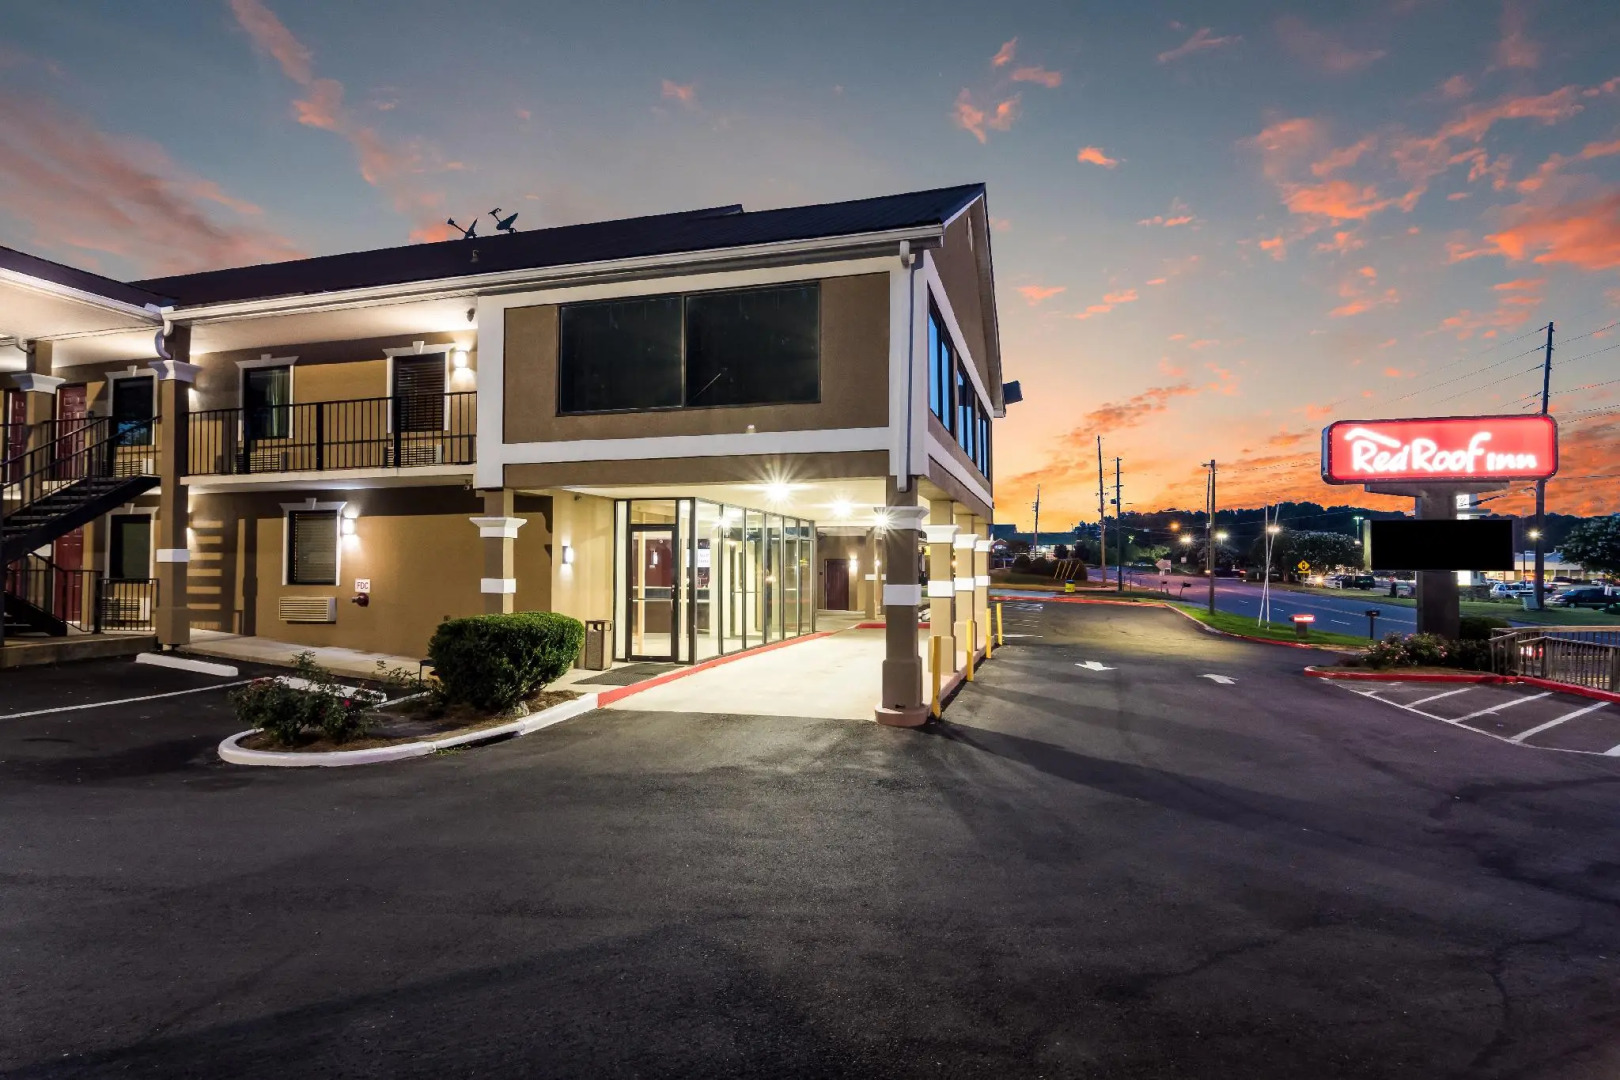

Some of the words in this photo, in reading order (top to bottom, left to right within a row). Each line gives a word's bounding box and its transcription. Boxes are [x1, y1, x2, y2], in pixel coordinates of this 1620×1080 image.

[1353, 440, 1410, 473] Red
[1411, 432, 1492, 473] Roof
[356, 582, 369, 590] FDC
